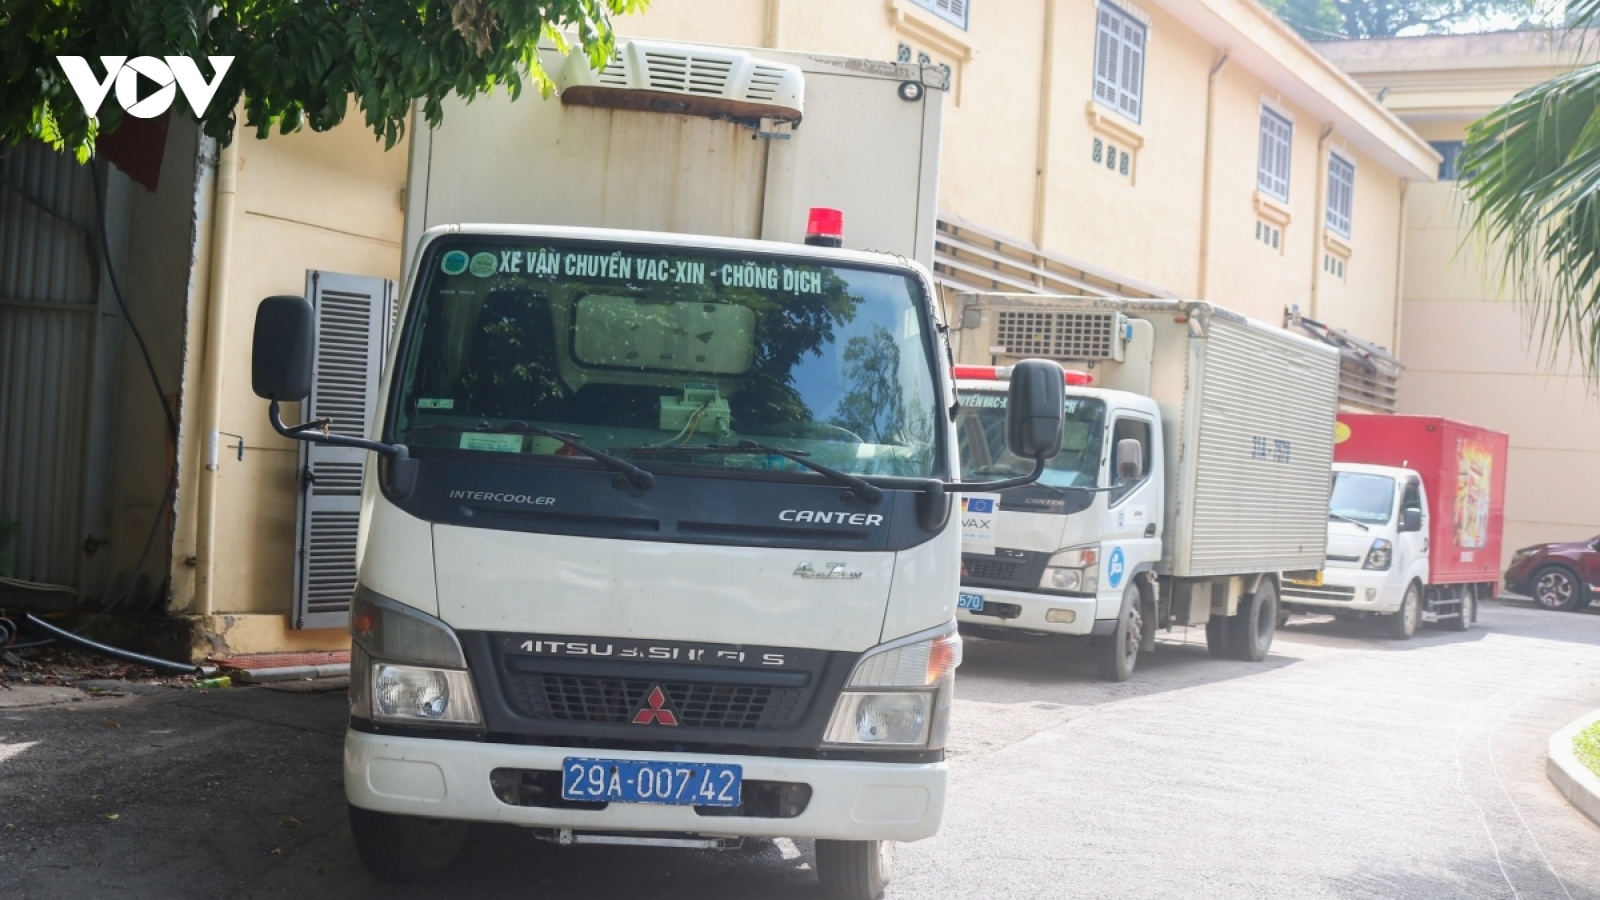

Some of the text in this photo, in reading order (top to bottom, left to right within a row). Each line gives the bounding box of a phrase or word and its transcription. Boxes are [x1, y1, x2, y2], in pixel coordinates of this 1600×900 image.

[500, 251, 521, 272] XE
[527, 248, 560, 278] VẬN
[565, 251, 631, 279] CHUYỂN
[637, 259, 704, 284] VAC-XIN
[722, 261, 778, 290] CHỐNG
[783, 268, 821, 295] DỊCH
[449, 490, 556, 506] INTERCOOLER
[778, 508, 884, 527] CANTER
[567, 763, 734, 801] 29A-007.42
